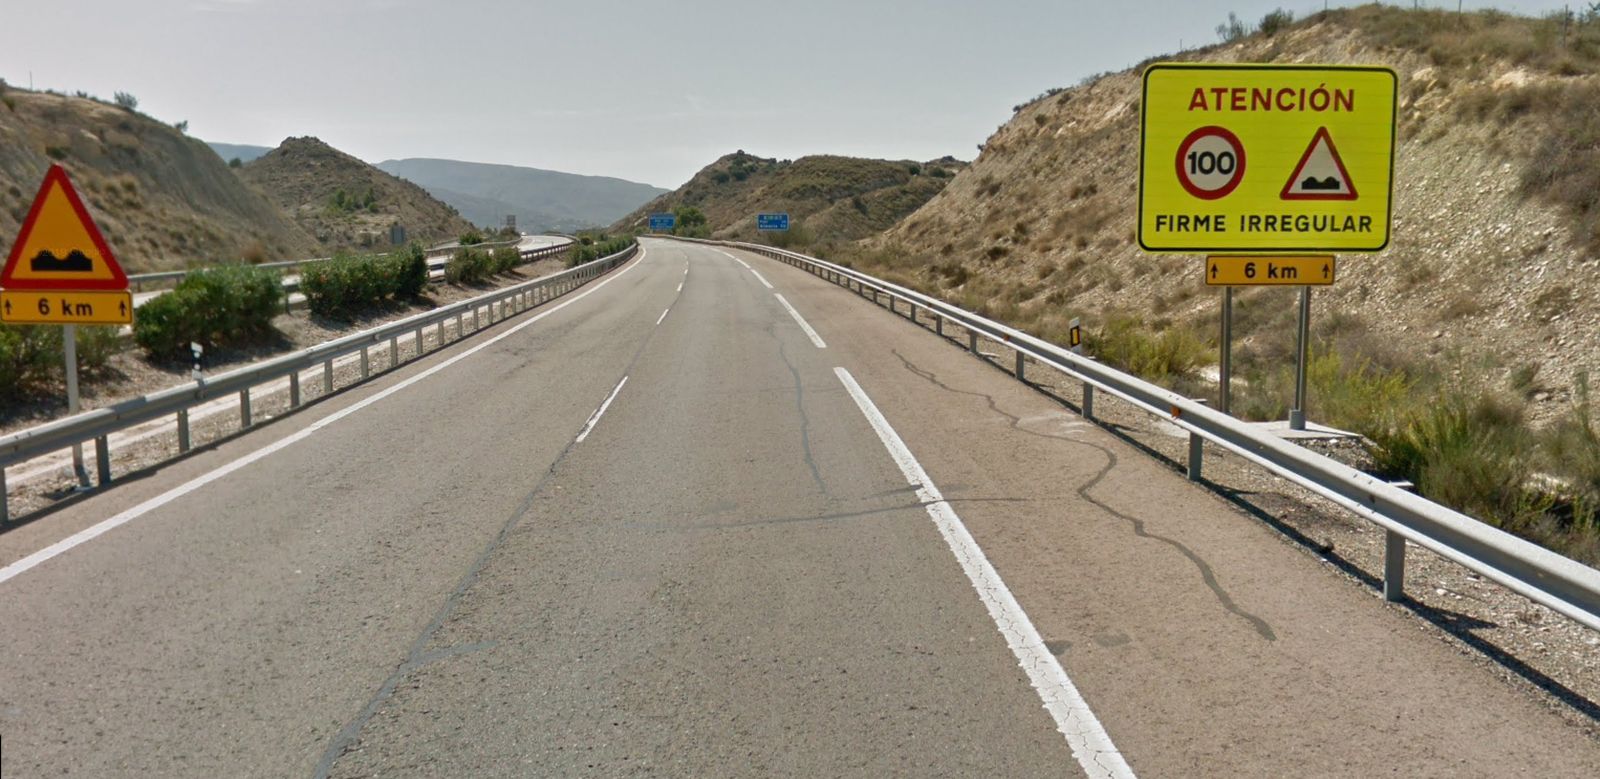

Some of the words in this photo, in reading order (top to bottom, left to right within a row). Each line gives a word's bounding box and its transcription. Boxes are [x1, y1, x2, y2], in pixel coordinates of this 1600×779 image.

[1188, 83, 1355, 112] ATENCIÓN
[1187, 151, 1235, 175] 100
[1155, 215, 1226, 232] FIRME
[1240, 215, 1373, 232] IRREGULAR
[1244, 262, 1256, 279] 6
[1267, 262, 1298, 279] km
[38, 298, 50, 315] 6
[62, 299, 93, 316] km
